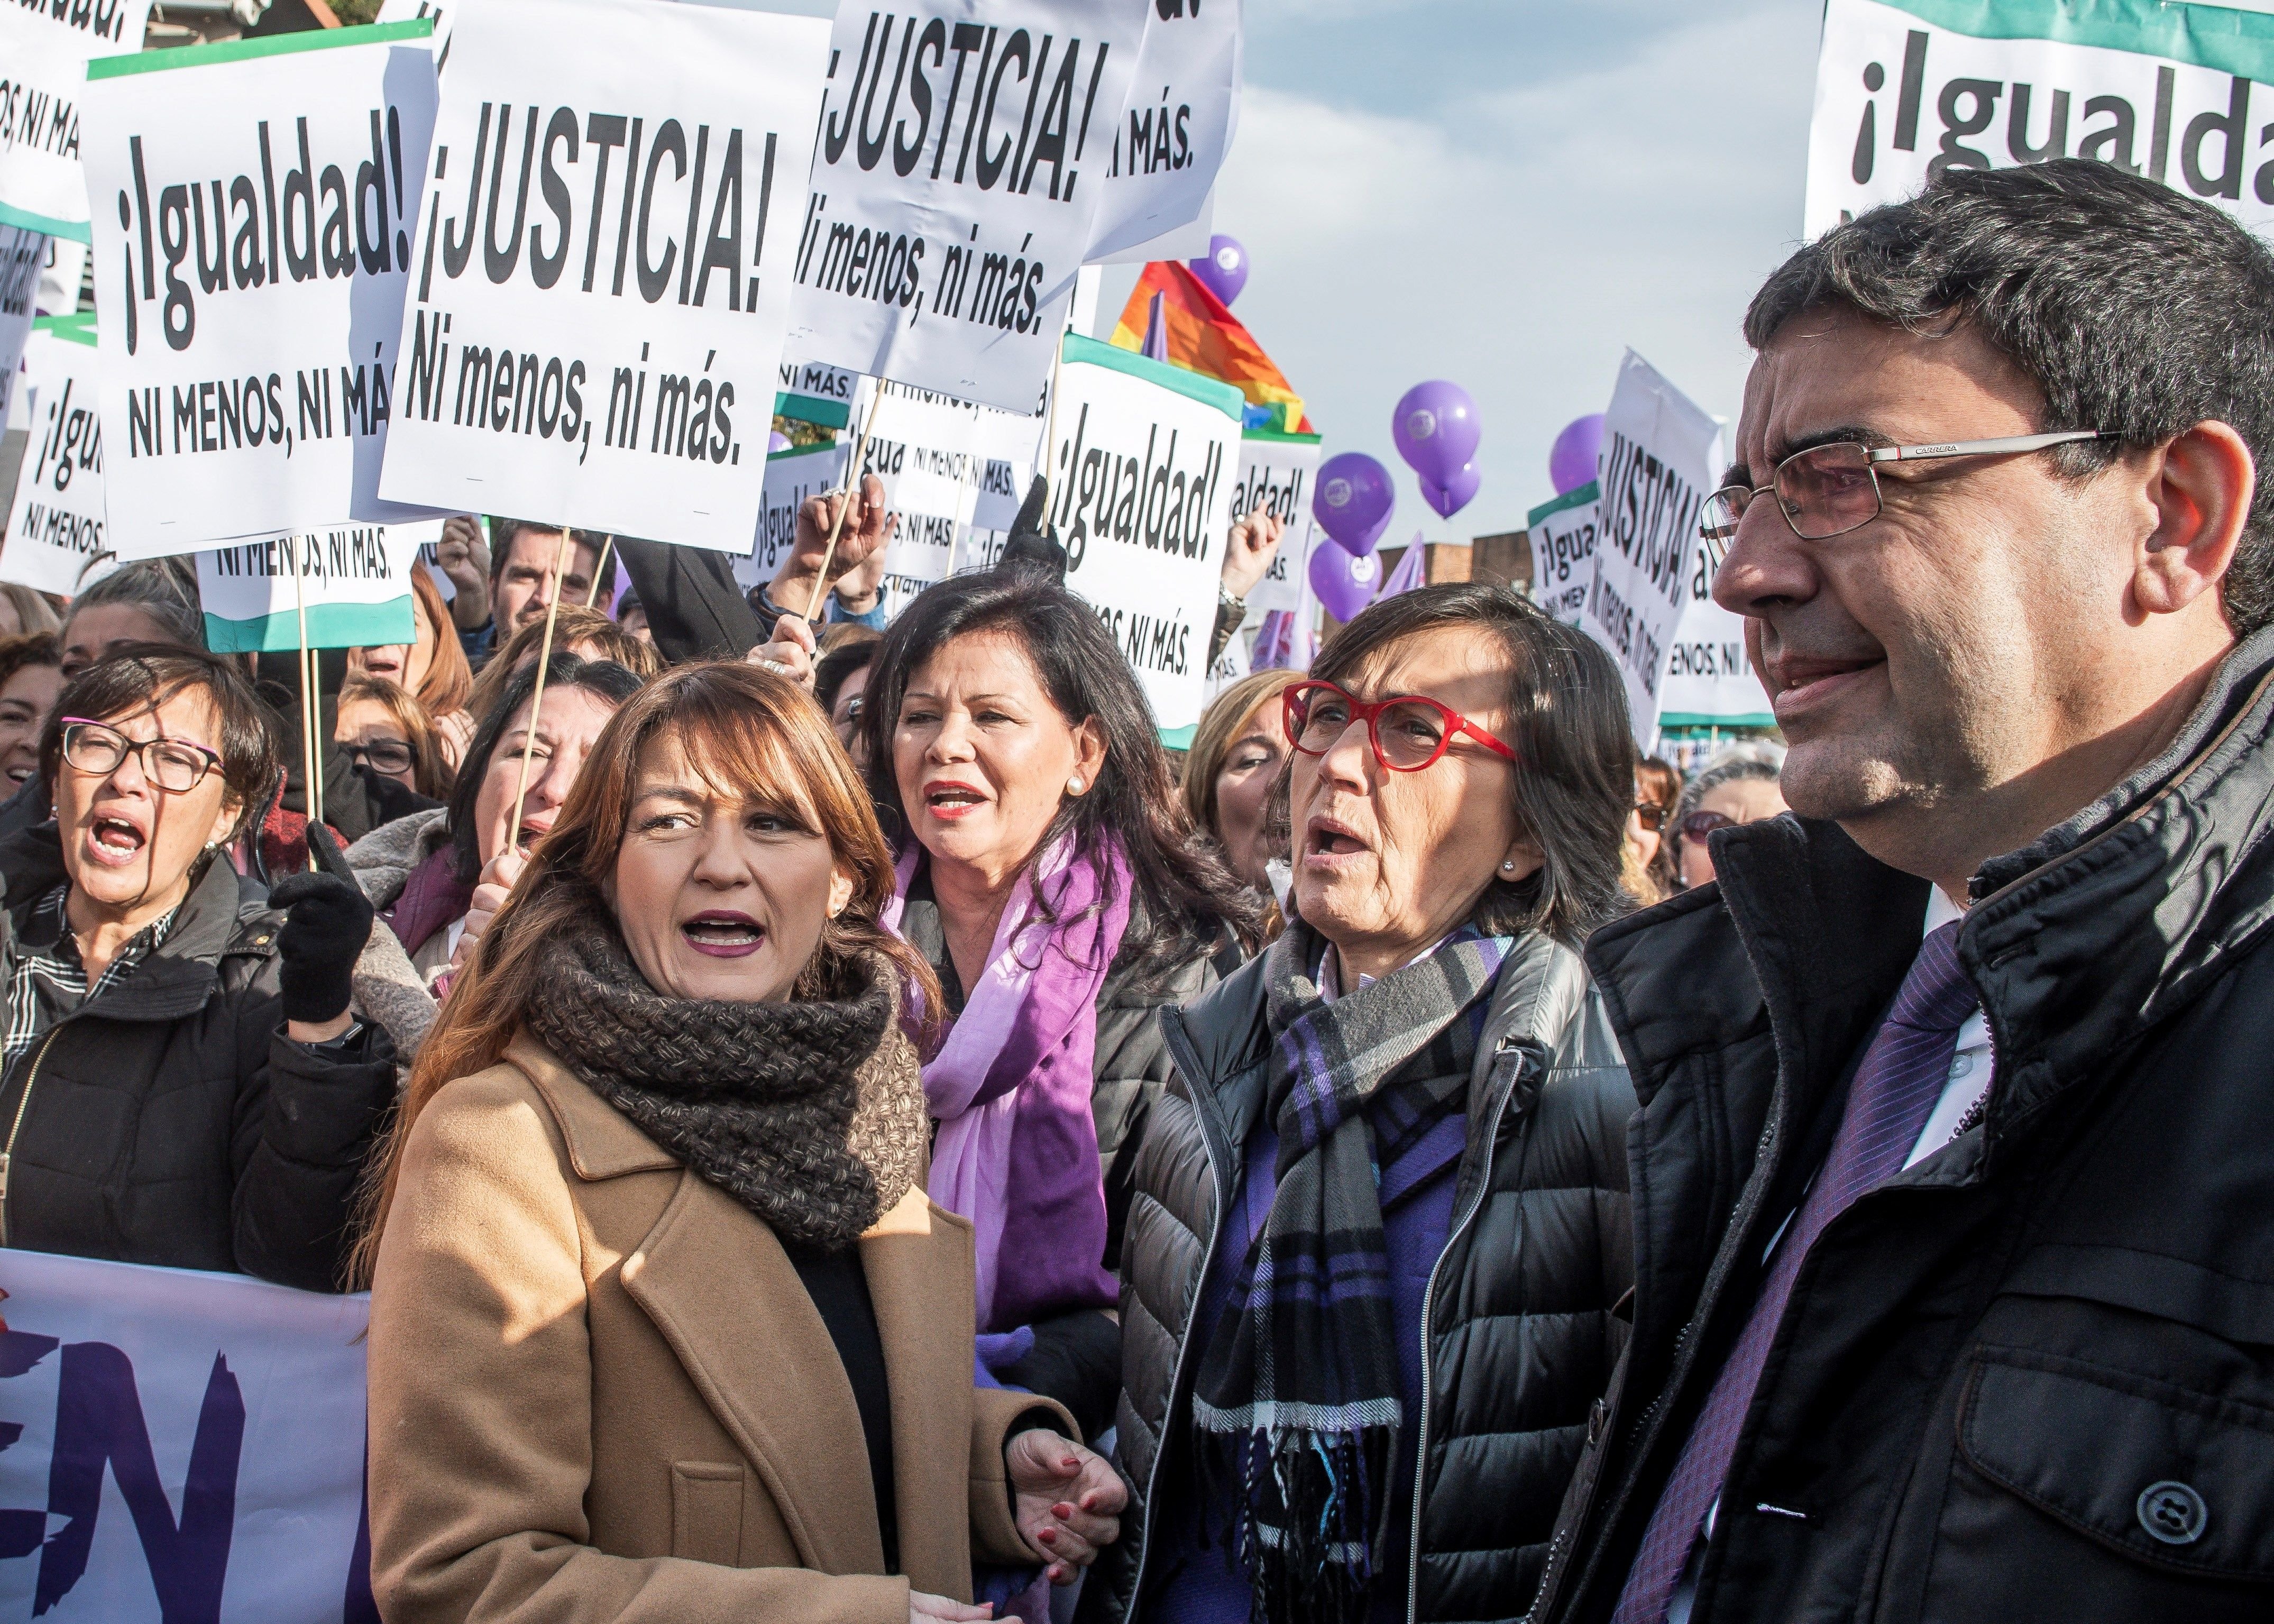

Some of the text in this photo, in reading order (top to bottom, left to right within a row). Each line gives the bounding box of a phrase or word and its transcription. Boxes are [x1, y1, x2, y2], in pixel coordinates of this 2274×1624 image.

[1129, 85, 1193, 176] MÁS.
[118, 105, 410, 356] ¡Igualdad!
[418, 102, 777, 313] ¡JUSTICIA!
[815, 222, 925, 328] menos,
[933, 224, 979, 318] ni
[978, 233, 1044, 336] más.
[33, 377, 100, 491] ¡Igu
[129, 341, 397, 460] NI MENOS, NI MÁ
[406, 309, 741, 466] Ni menos, ni más.
[804, 366, 849, 399] MÁS.
[1050, 402, 1222, 572] ¡Igualdad!
[1915, 445, 1958, 454] CARRERA
[328, 531, 349, 578] NI
[1126, 613, 1151, 666] NI
[1149, 607, 1190, 676] MÁS.
